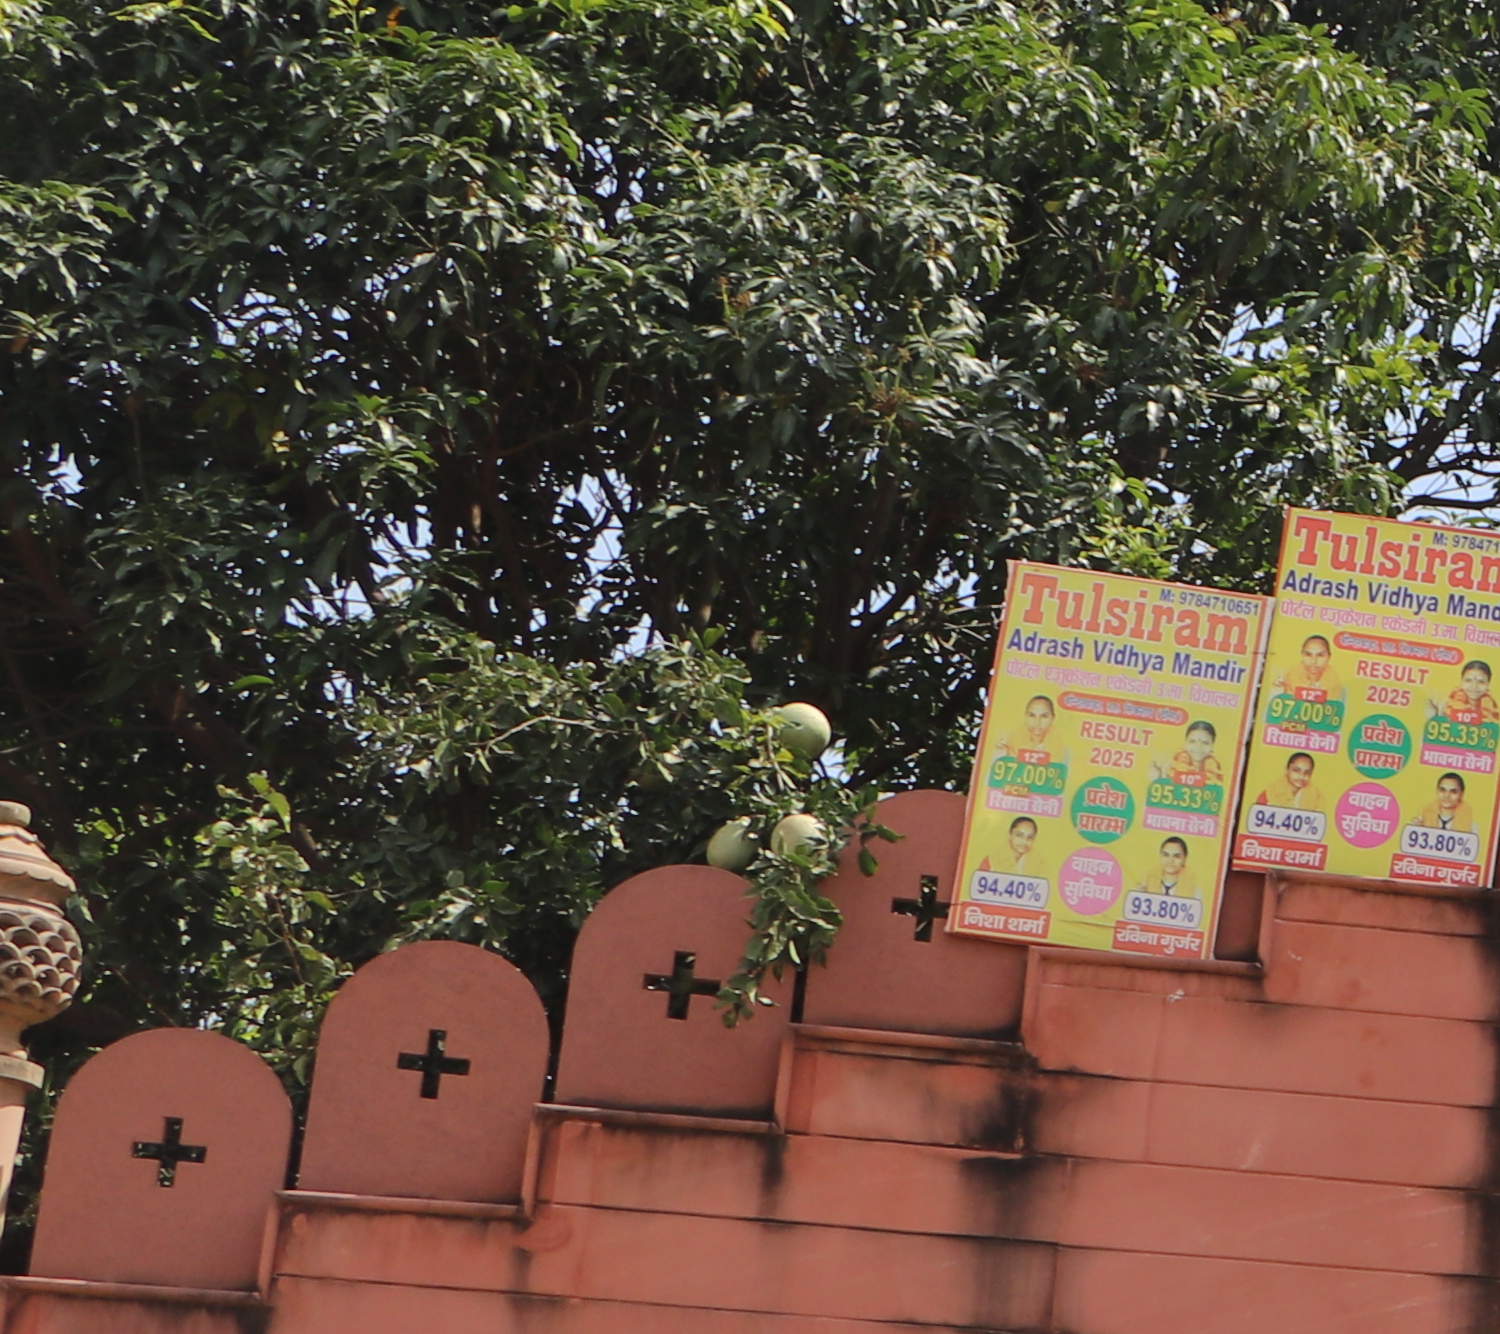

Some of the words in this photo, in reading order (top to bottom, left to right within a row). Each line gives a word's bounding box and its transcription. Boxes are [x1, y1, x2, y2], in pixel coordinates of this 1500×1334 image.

[1178, 591, 1259, 615] 9784710651
[1282, 569, 1358, 601] Adrash
[1368, 581, 1439, 615] Vidhya
[1019, 572, 1249, 655] Tulsiram
[1007, 628, 1084, 660] Adrash
[1093, 640, 1165, 674] Vidhya
[1171, 652, 1247, 683] Mandir
[1355, 659, 1429, 685] RESULT
[1365, 685, 1411, 707] 2025
[1270, 698, 1343, 727] 97.00%
[1080, 720, 1154, 746] RESULT
[1361, 721, 1403, 745] प्रवेश
[1426, 721, 1497, 750] 95.33%
[1090, 747, 1136, 769] 2025
[993, 760, 1067, 790] 97.00%
[1150, 783, 1222, 813] 95.33%
[1348, 791, 1391, 811] वाहन
[1253, 809, 1320, 835] 94.40%
[1240, 839, 1283, 861] निशा
[1283, 846, 1323, 866] शर्मा
[1407, 830, 1472, 856] 93.80%
[976, 876, 1043, 902] 94.40%
[1130, 896, 1195, 923] 93.80%
